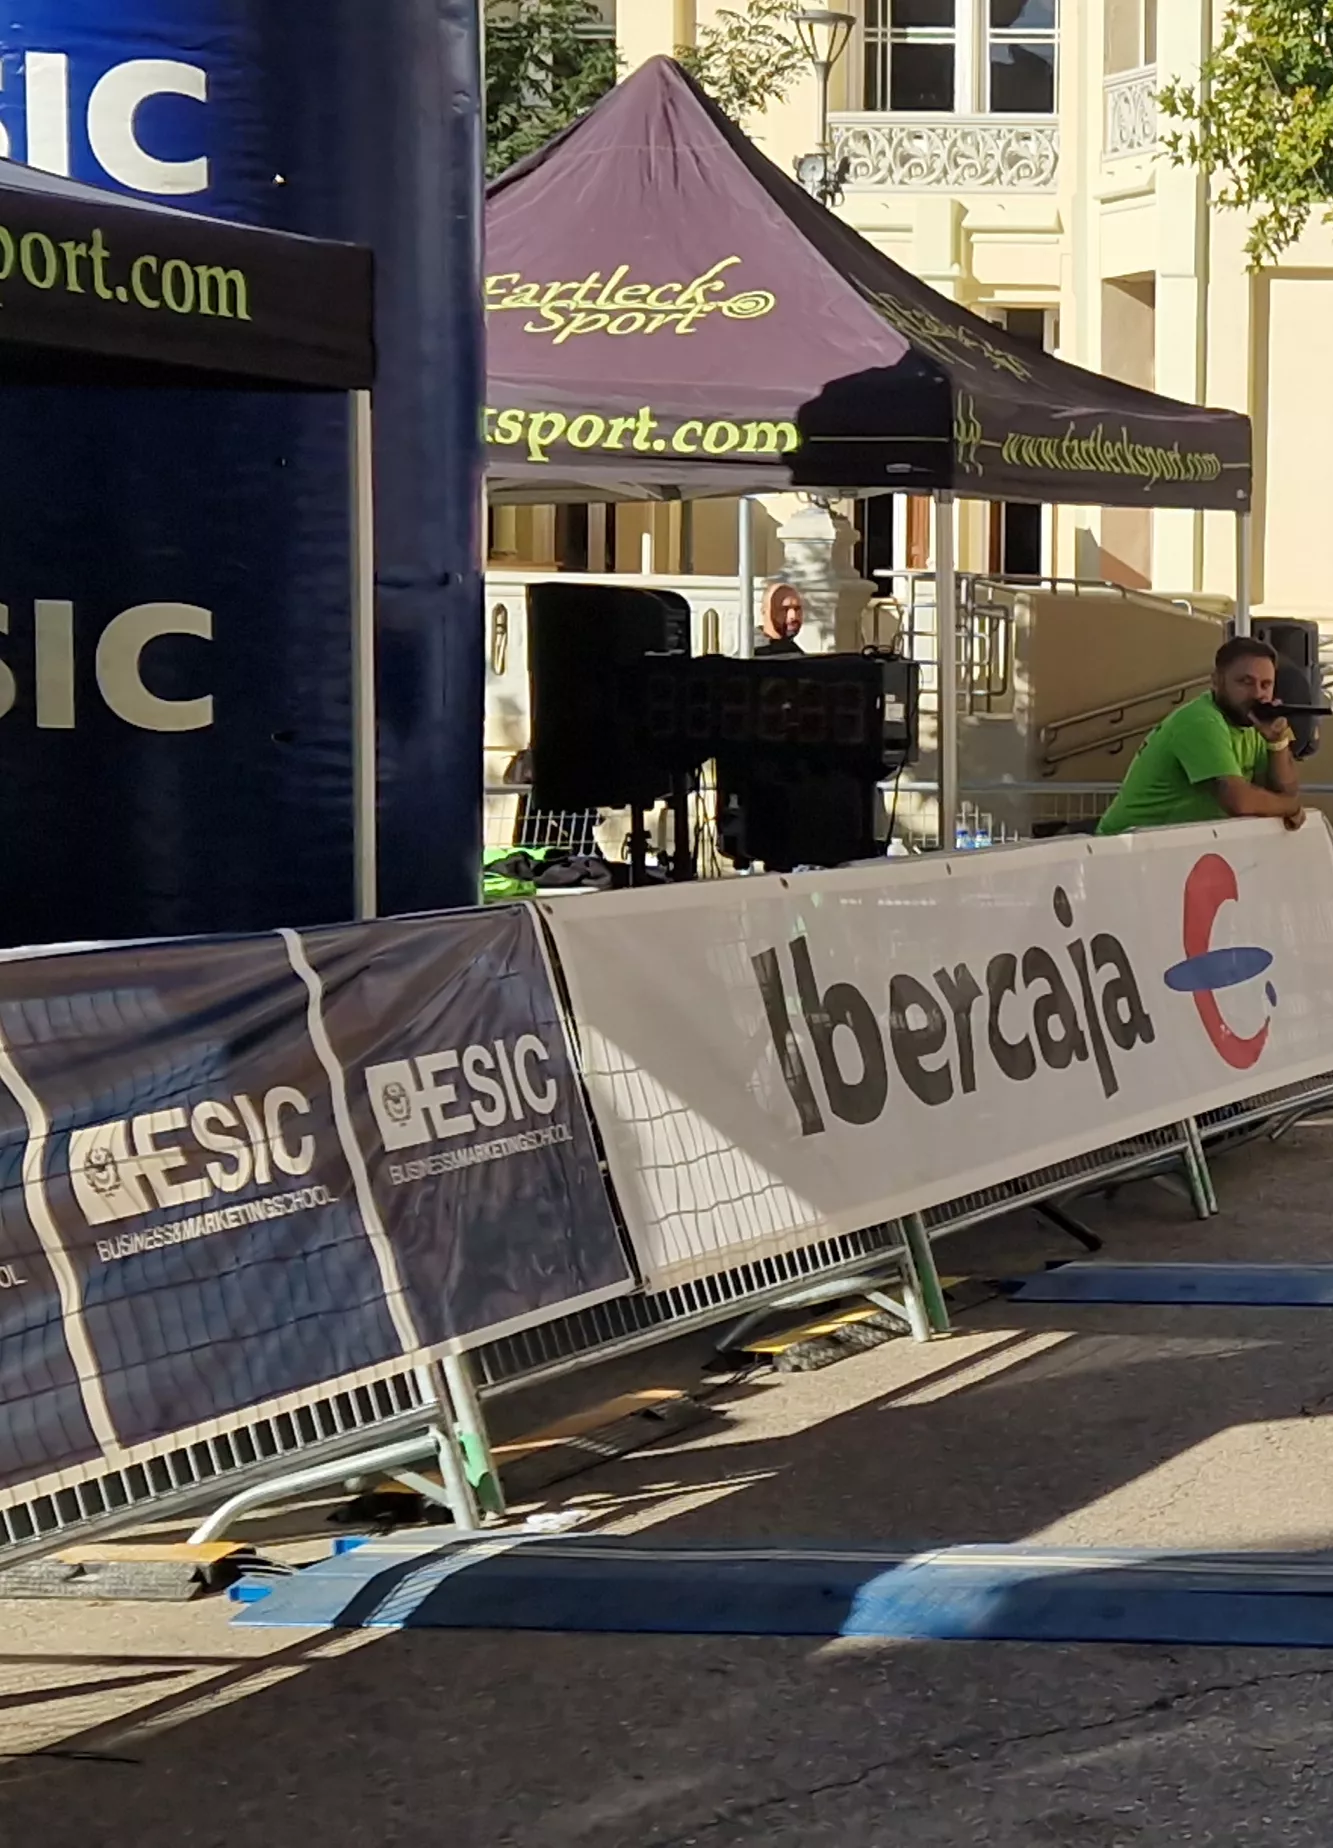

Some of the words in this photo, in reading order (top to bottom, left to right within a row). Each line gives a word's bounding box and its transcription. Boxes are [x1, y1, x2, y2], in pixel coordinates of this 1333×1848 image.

[0, 50, 209, 195] IC
[524, 300, 707, 345] Sport
[1001, 420, 1222, 492] www.fartlecksport.com
[0, 598, 214, 732] IC
[752, 886, 1156, 1136] Ibercaja
[131, 1086, 317, 1208] ESIC
[413, 1034, 558, 1139] ESIC
